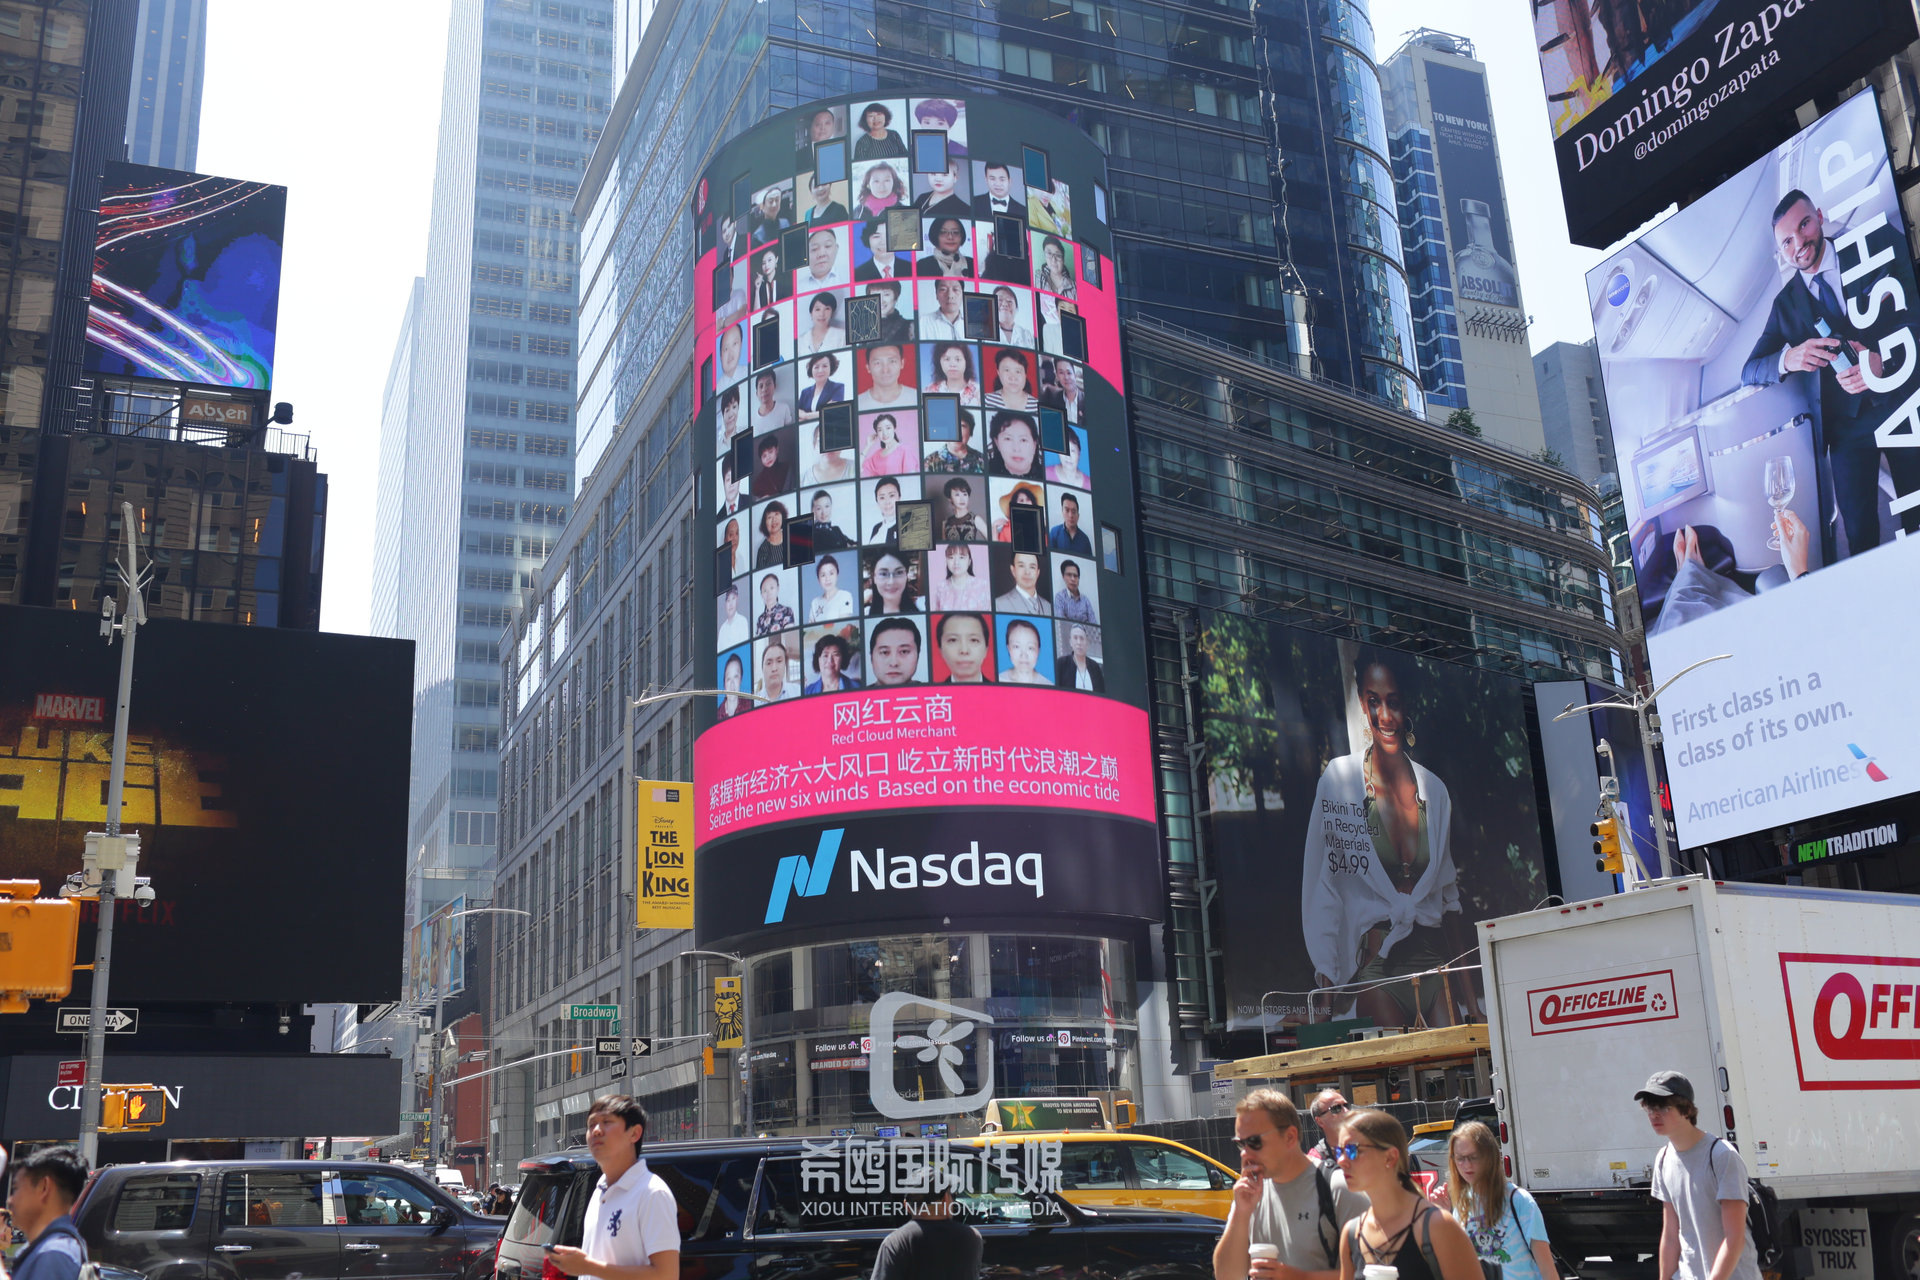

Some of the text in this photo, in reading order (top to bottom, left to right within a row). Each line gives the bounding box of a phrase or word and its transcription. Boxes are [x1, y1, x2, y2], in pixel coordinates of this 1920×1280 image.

[1574, 0, 1815, 172] Domingo Zapa
[1633, 49, 1780, 161] @domingozapata
[1433, 112, 1444, 122] TO
[1445, 114, 1464, 127] NEW
[1818, 140, 1920, 546] AGSHIP
[188, 402, 247, 422] Absen
[35, 695, 103, 720] MARVEL
[833, 693, 952, 731] 网红云商
[1671, 672, 1822, 735] First class in a
[0, 726, 154, 763] UKE
[832, 725, 957, 745] Red Cloud Merchant
[1677, 701, 1853, 768] class of its own.
[709, 745, 1119, 811] 紧握新经济六大风口 屹立新时代浪潮之巅
[709, 774, 1120, 831] Seize the new six winds Based on the economic tide
[1688, 782, 1778, 823] American
[1781, 761, 1862, 799] Airlines
[1321, 799, 1369, 821] Bikini Top
[650, 831, 678, 844] THE
[1323, 817, 1380, 837] in Recycled
[1325, 834, 1371, 852] Materials
[645, 846, 684, 869] LION
[1328, 850, 1369, 875] $4.99
[850, 841, 1044, 899] Nasdaq
[642, 871, 690, 898] KING
[573, 1006, 617, 1019] Broadway
[1237, 1005, 1254, 1015] NOW
[1264, 1005, 1291, 1015] STORES
[1292, 1006, 1306, 1015] AND
[1539, 985, 1648, 1025] OFFICELINE
[69, 1016, 90, 1025] ONE
[603, 1043, 620, 1051] ONE
[815, 1044, 837, 1053] Follow
[1011, 1035, 1035, 1043] Follow
[811, 1058, 867, 1070] BRANDED CITIES
[401, 1113, 429, 1121] BROADWAY
[1804, 1228, 1867, 1248] SYOSSET
[1818, 1251, 1857, 1270] TRUX
